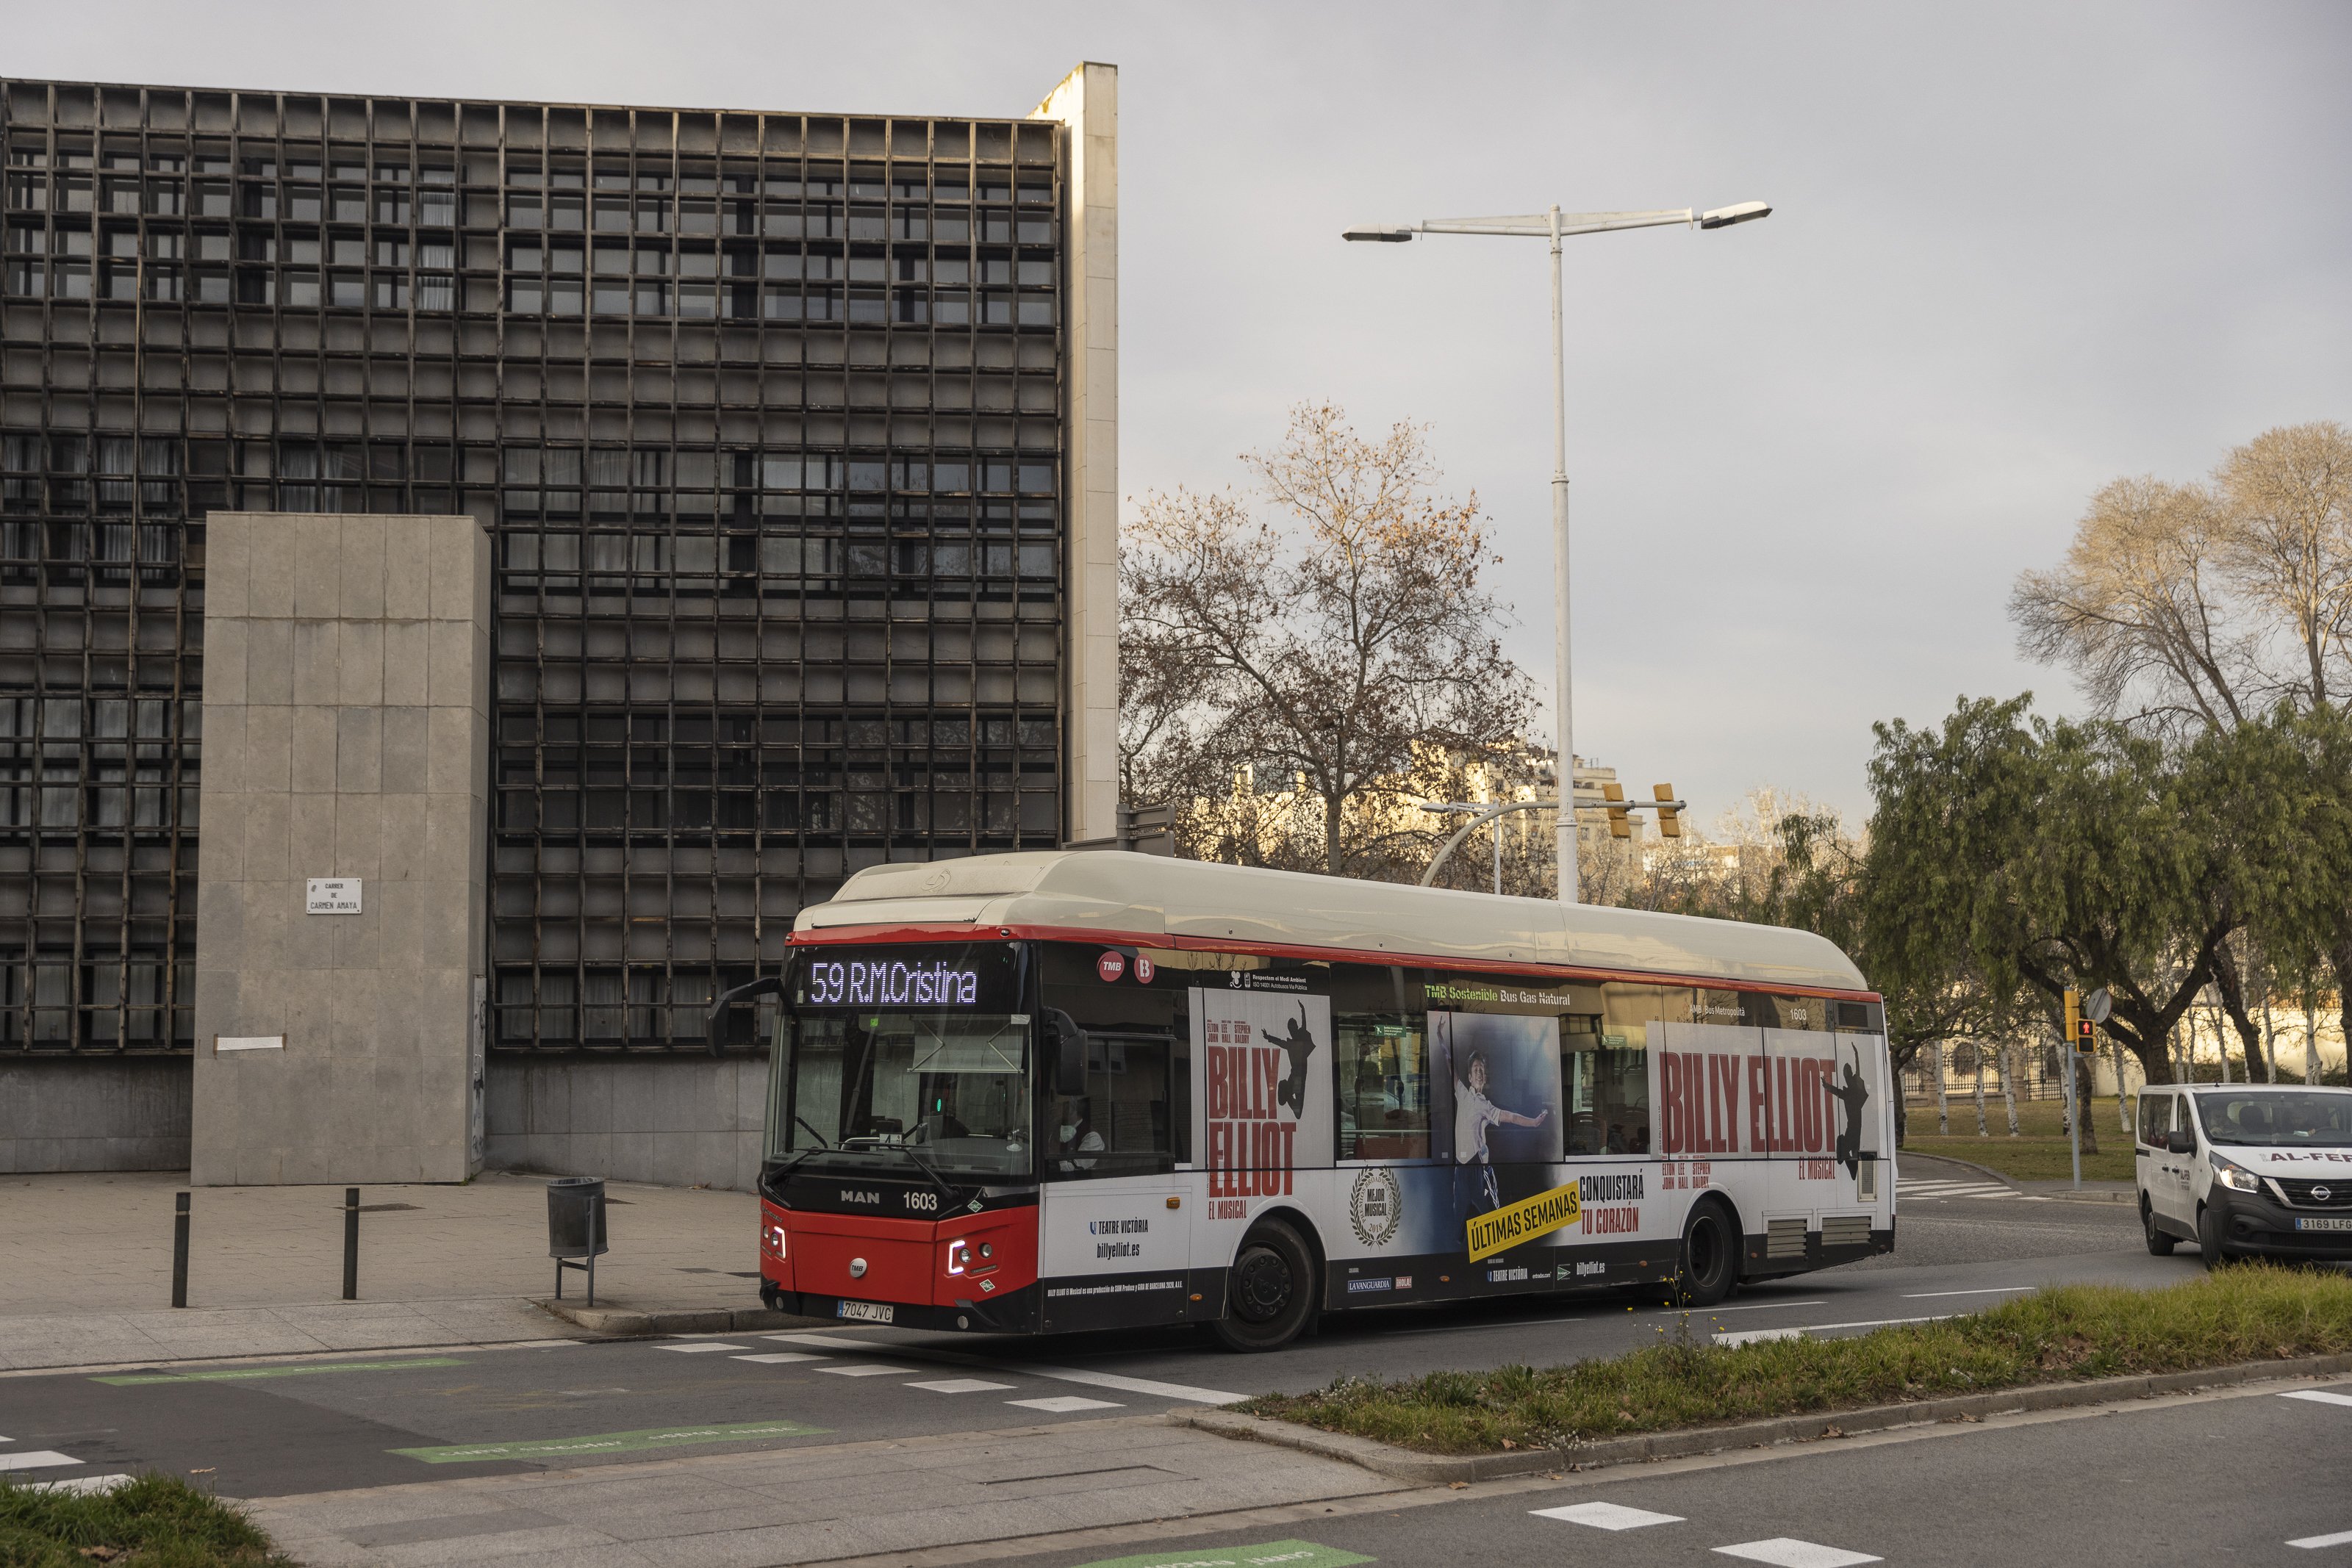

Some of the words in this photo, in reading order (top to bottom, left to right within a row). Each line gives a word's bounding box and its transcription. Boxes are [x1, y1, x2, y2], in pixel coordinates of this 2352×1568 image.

[310, 902, 334, 910] CARMEN
[337, 902, 357, 910] AMAYA
[1103, 961, 1122, 971] TMB
[811, 963, 844, 1002] 59
[1424, 985, 1446, 999] TMB
[1449, 986, 1497, 1001] Sostenible
[1500, 990, 1517, 1003] Bus
[1520, 990, 1536, 1004] Gas
[1539, 992, 1570, 1006] Natural
[1690, 1004, 1702, 1014] AMB
[1704, 1005, 1714, 1015] Bus
[1715, 1006, 1746, 1017] Metropolità
[1790, 1008, 1807, 1020] 1603
[1208, 1023, 1219, 1032] ELTON
[1235, 1025, 1250, 1034] STEPHEN
[1208, 1033, 1218, 1043] JOHN
[1222, 1034, 1230, 1043] HALL
[1208, 1046, 1280, 1119] BILLY
[1659, 1051, 1740, 1154] BILLY
[1747, 1055, 1836, 1153] ELLIOT
[1209, 1121, 1296, 1198] ELLIOT
[1663, 1163, 1674, 1176] ELTON
[1693, 1162, 1710, 1175] STEPHEN
[1799, 1156, 1805, 1180] EL
[1807, 1156, 1835, 1180] MUSICAL
[1580, 1168, 1644, 1204] CONQUISTARÁ
[1663, 1177, 1674, 1190] JOHN
[1679, 1176, 1688, 1189] HALL
[1693, 1176, 1709, 1188] DALDRY
[841, 1190, 880, 1204] MAN
[903, 1191, 938, 1211] 1603
[1367, 1188, 1385, 1202] MEJOR
[1208, 1201, 1215, 1220] EL
[1218, 1200, 1247, 1220] MUSICAL
[1365, 1203, 1386, 1217] MUSICAL
[1471, 1212, 1521, 1252] ÚLTIMAS
[1524, 1191, 1577, 1236] SEMANAS
[1582, 1209, 1593, 1234] TU
[1596, 1201, 1639, 1234] CORAZÓN
[2303, 1220, 2328, 1229] 3169
[2333, 1220, 2352, 1229] LFG
[1099, 1220, 1119, 1234] TEATRE
[1121, 1217, 1148, 1234] VICTÒRIA
[1369, 1223, 1383, 1233] 2018
[1097, 1242, 1139, 1260] billyelliot.es
[1494, 1270, 1507, 1282] TEATRE
[1508, 1266, 1528, 1281] VICTÒRIA
[1577, 1261, 1605, 1276] billyelliot.es
[845, 1303, 869, 1317] 7047
[872, 1306, 891, 1320] JVC
